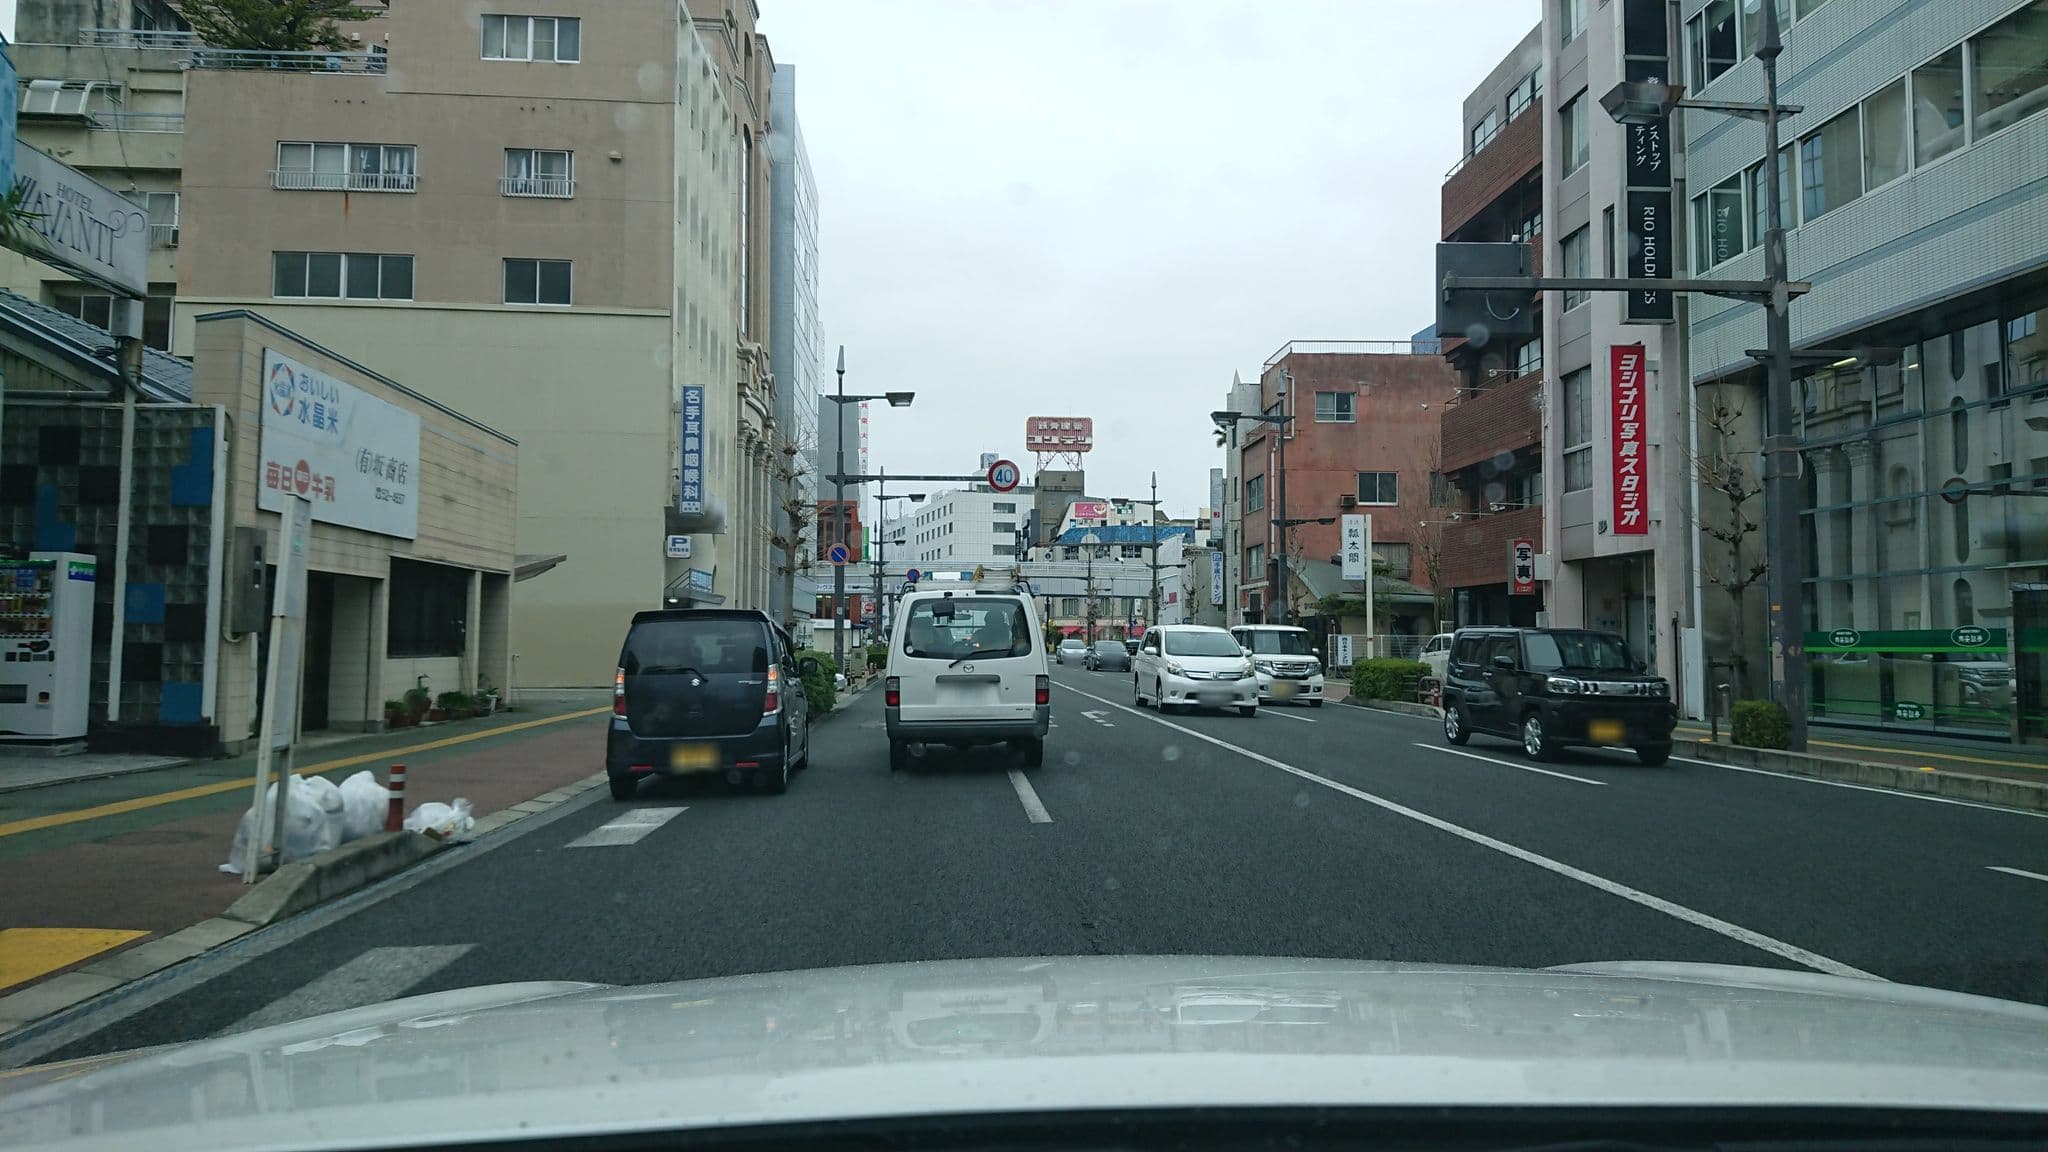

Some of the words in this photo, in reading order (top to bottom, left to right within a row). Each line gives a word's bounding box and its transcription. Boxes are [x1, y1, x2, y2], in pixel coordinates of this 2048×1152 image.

[56, 182, 94, 214] HOTEL
[1643, 206, 1656, 231] RIO
[299, 373, 340, 404] おいしい
[298, 397, 339, 434] 水晶米
[684, 389, 700, 500] 名手耳鼻咽喉科
[1618, 354, 1641, 527] ヨシナリ写真スタジオ
[995, 469, 1013, 483] 40
[671, 537, 688, 547] P
[1516, 547, 1532, 579] 写真
